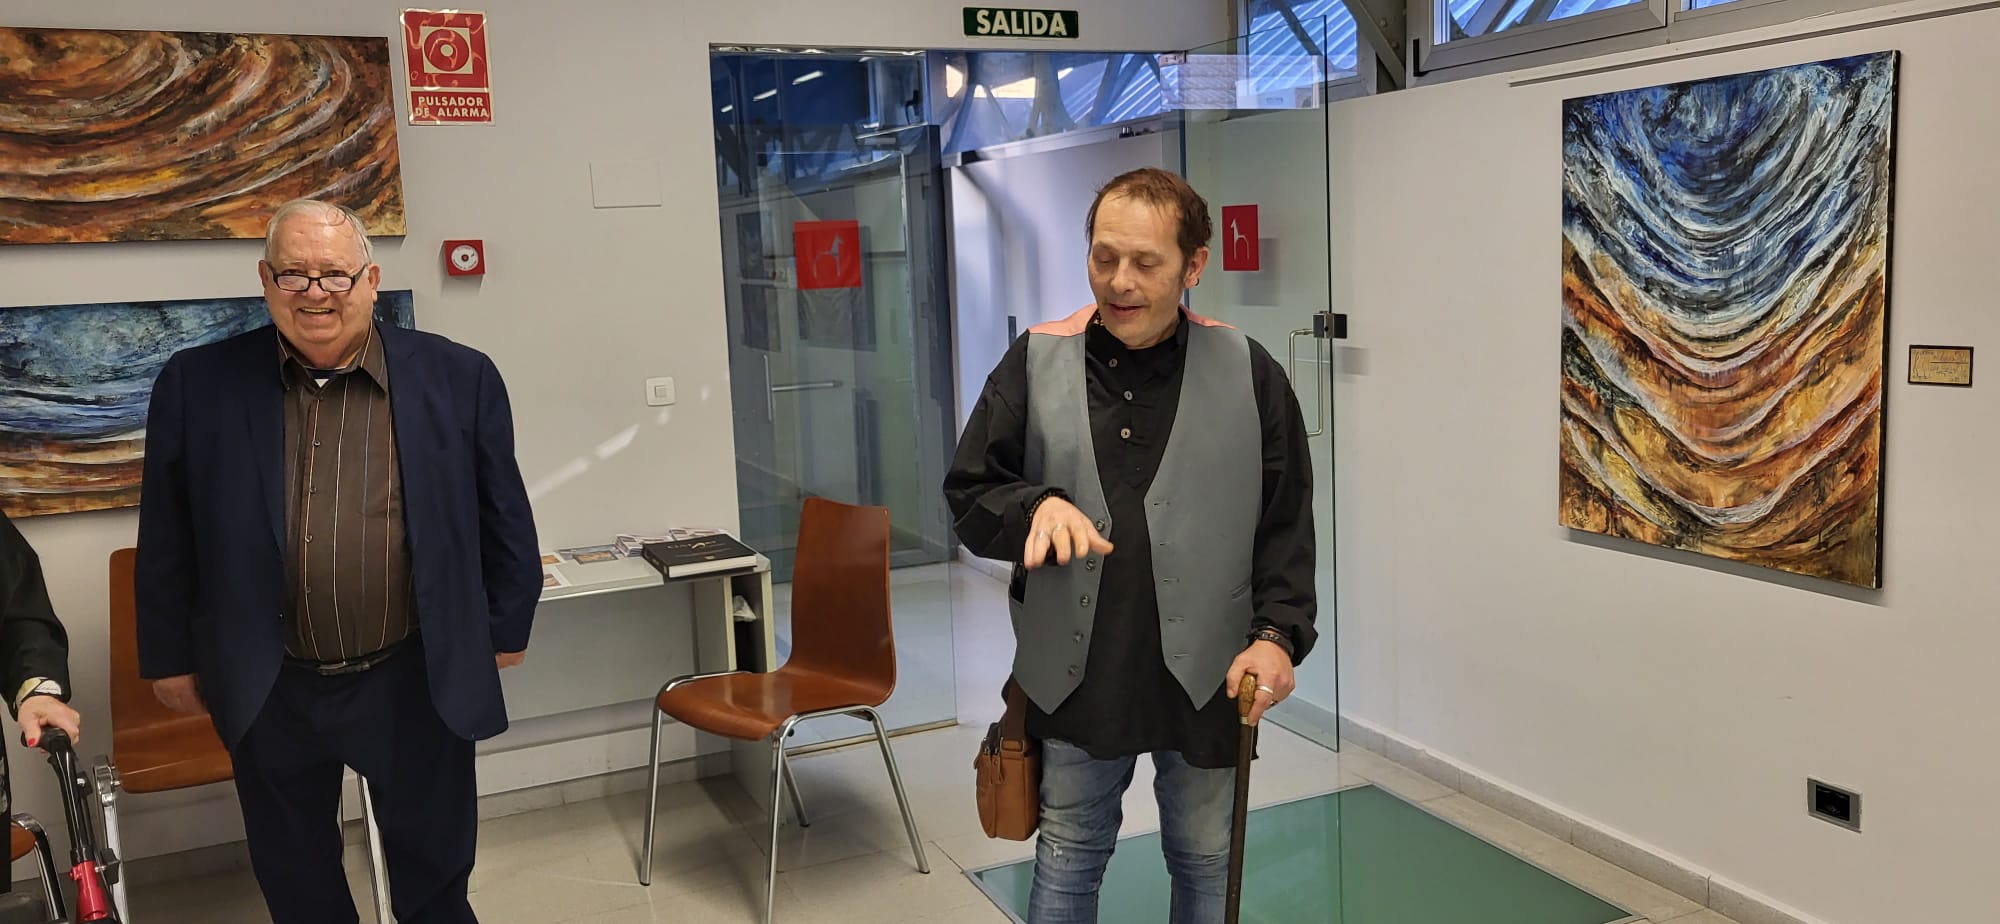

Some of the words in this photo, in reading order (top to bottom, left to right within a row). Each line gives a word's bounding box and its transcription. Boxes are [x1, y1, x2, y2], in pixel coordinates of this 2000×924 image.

[976, 9, 1068, 36] SALIDA
[418, 96, 483, 106] PULSADOR
[415, 107, 430, 117] DE
[437, 107, 489, 117] ALARMA
